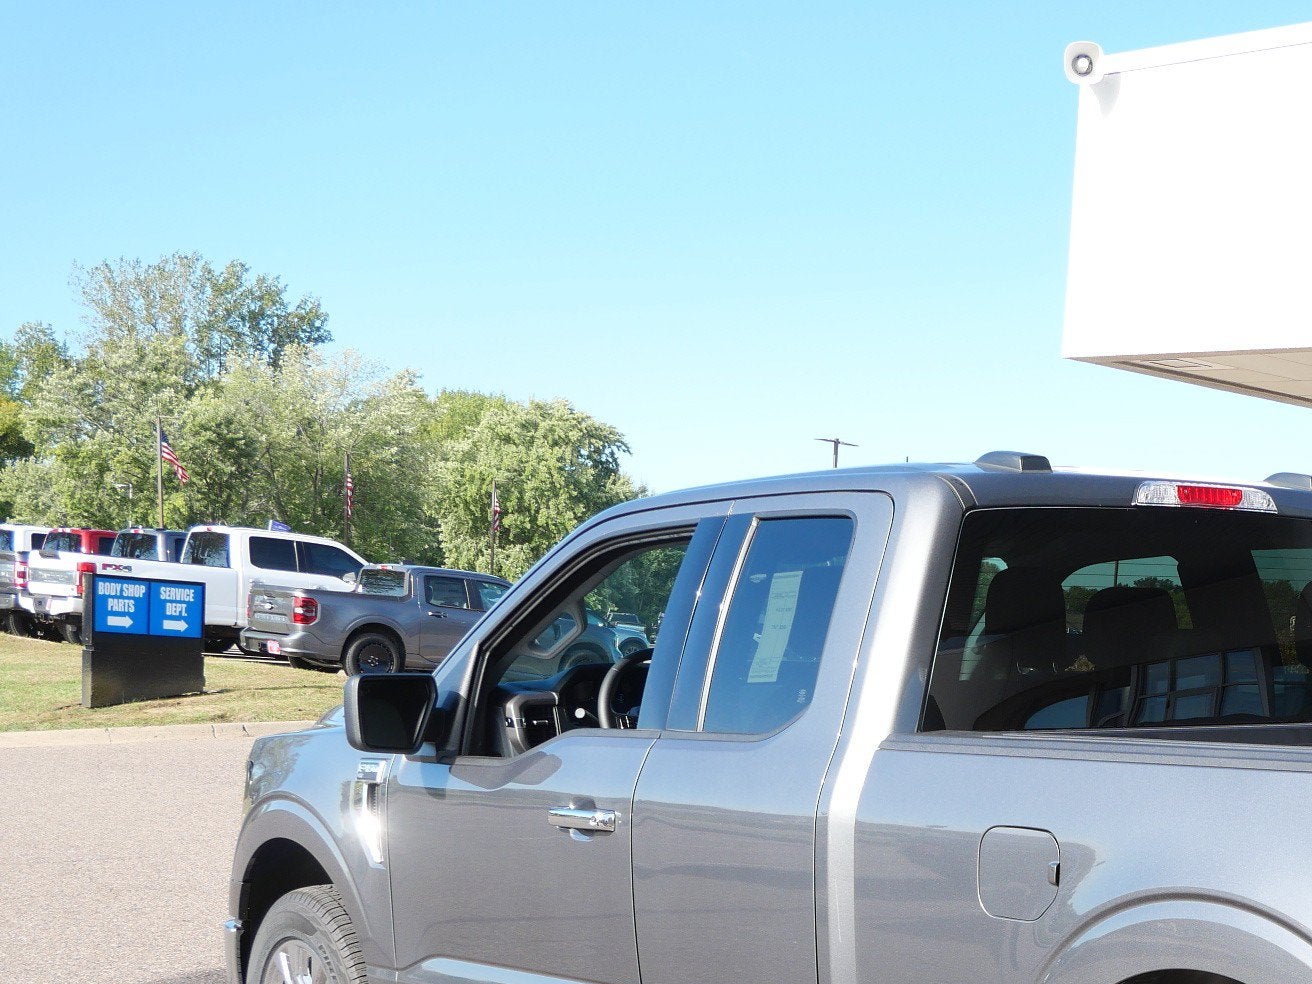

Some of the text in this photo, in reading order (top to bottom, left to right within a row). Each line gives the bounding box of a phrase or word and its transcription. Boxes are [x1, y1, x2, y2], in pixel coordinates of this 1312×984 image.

[98, 582, 146, 598] BODY SHOP
[160, 586, 195, 602] SERVICE
[108, 598, 135, 613] PARTS
[166, 603, 187, 616] DEPT.
